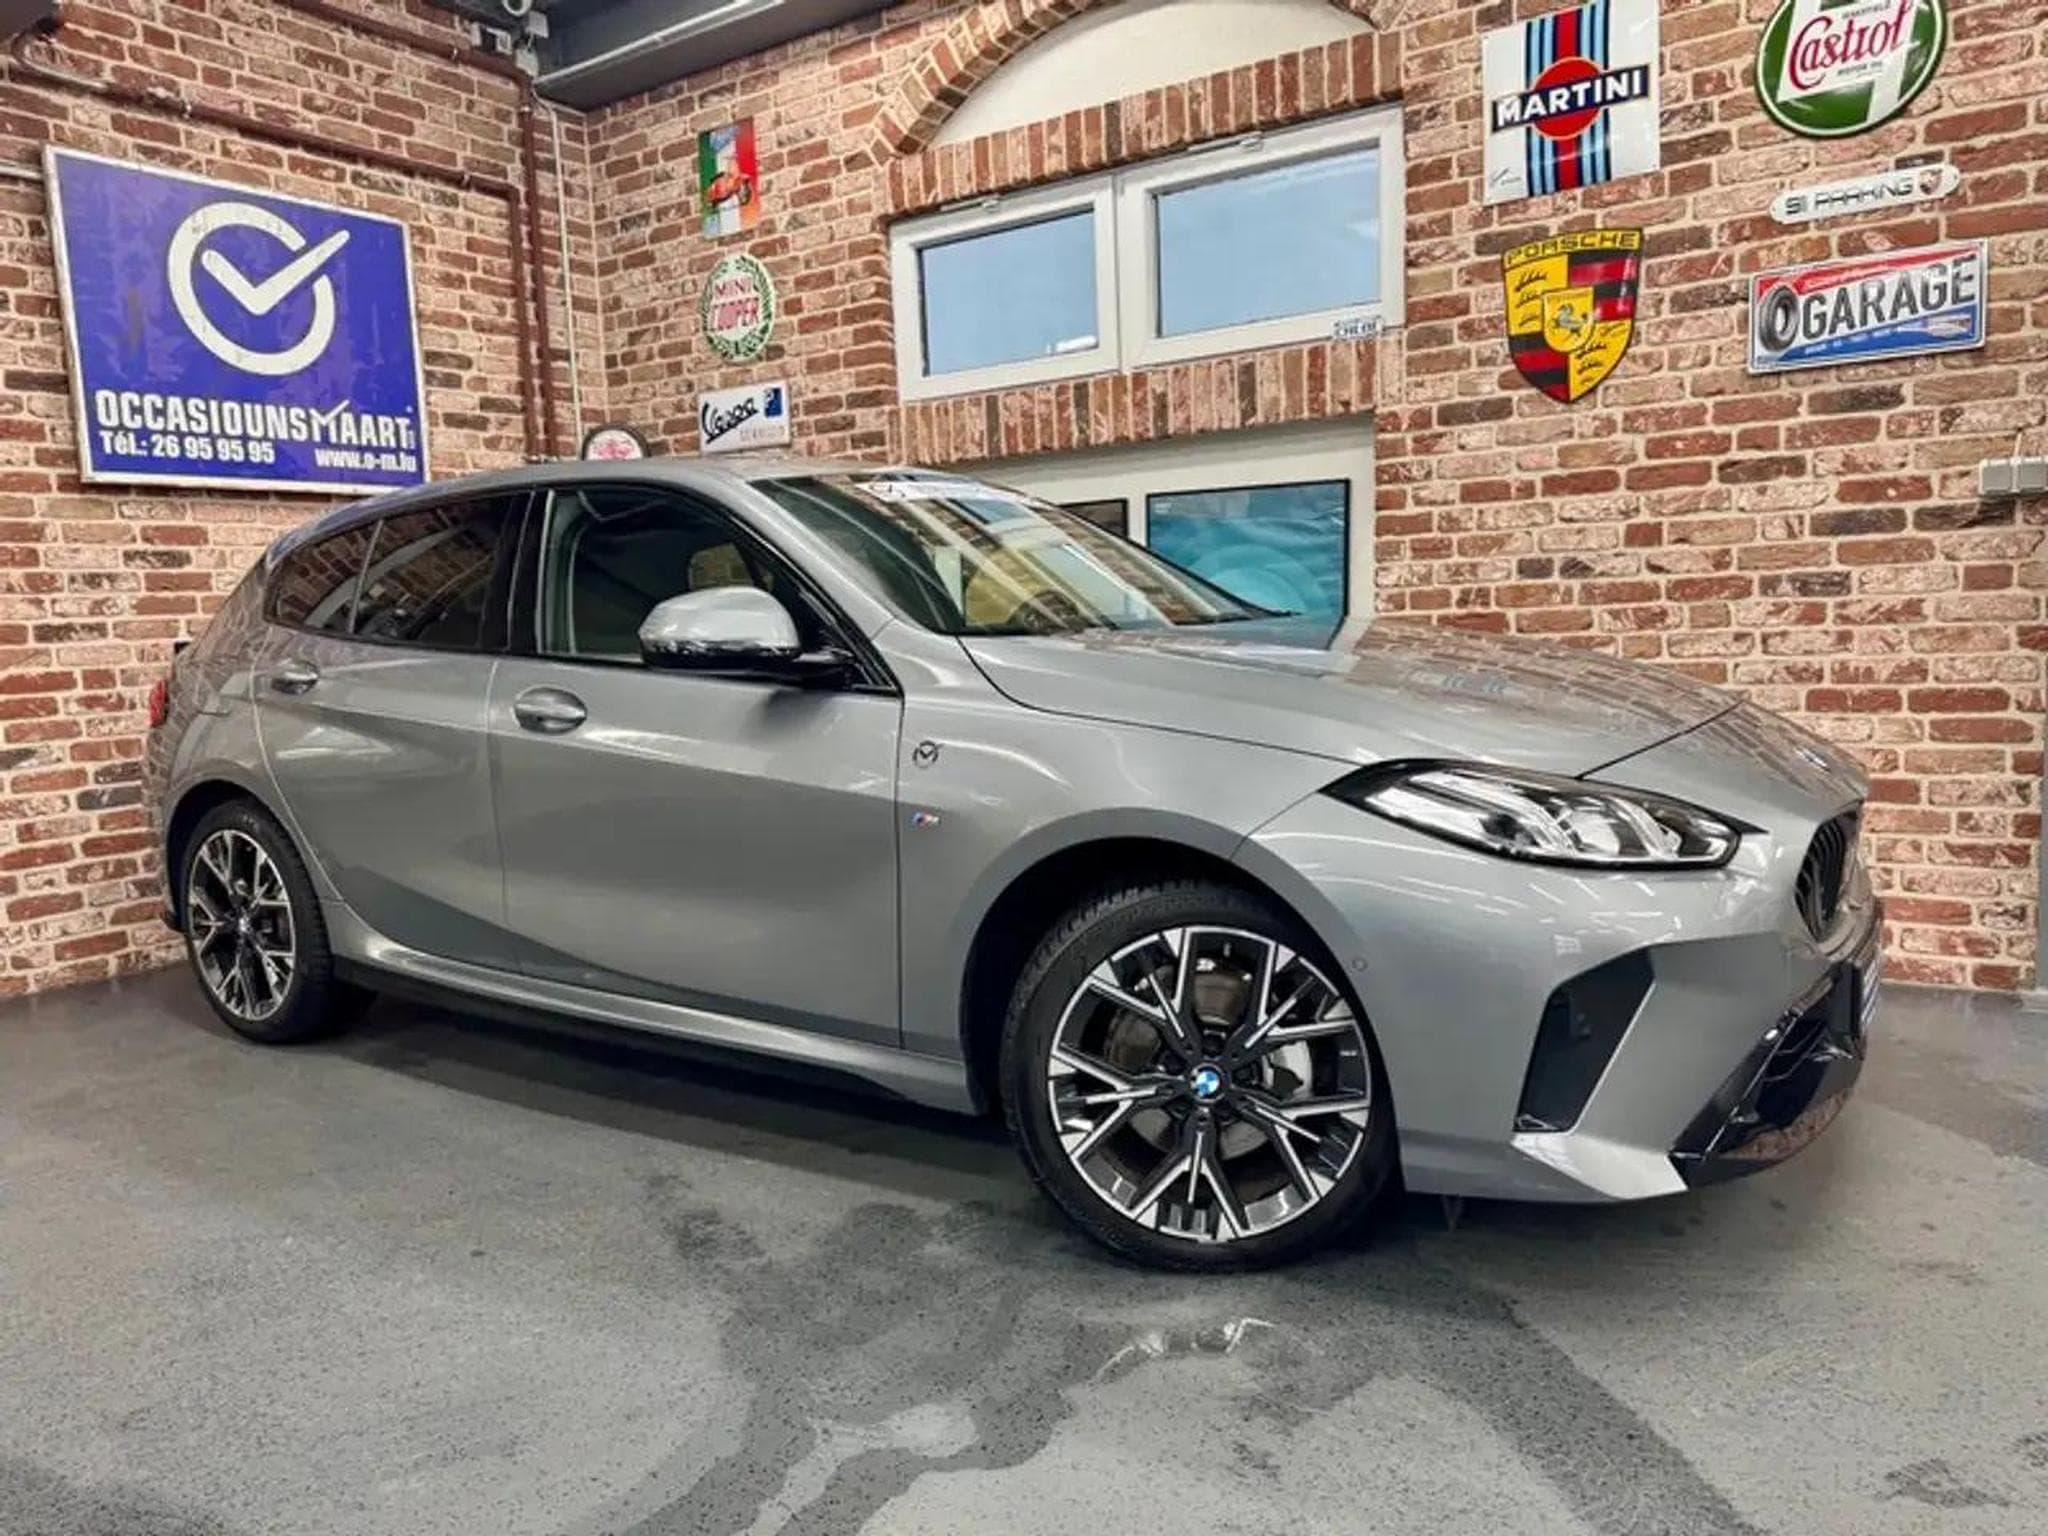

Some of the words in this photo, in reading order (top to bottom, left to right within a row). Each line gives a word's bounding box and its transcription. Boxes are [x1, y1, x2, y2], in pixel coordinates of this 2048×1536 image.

[1789, 0, 1912, 91] Castrol
[1497, 69, 1641, 127] MARTINI
[1507, 232, 1636, 266] PORSCHE
[1802, 253, 1977, 340] GARAGE
[95, 389, 411, 449] OCCASIOUNSMAART
[702, 397, 759, 444] Vespa
[151, 433, 180, 458] 26
[184, 436, 213, 460] 95
[216, 438, 245, 462] 95
[248, 440, 276, 464] 95
[315, 448, 417, 472] www.o-m.lu
